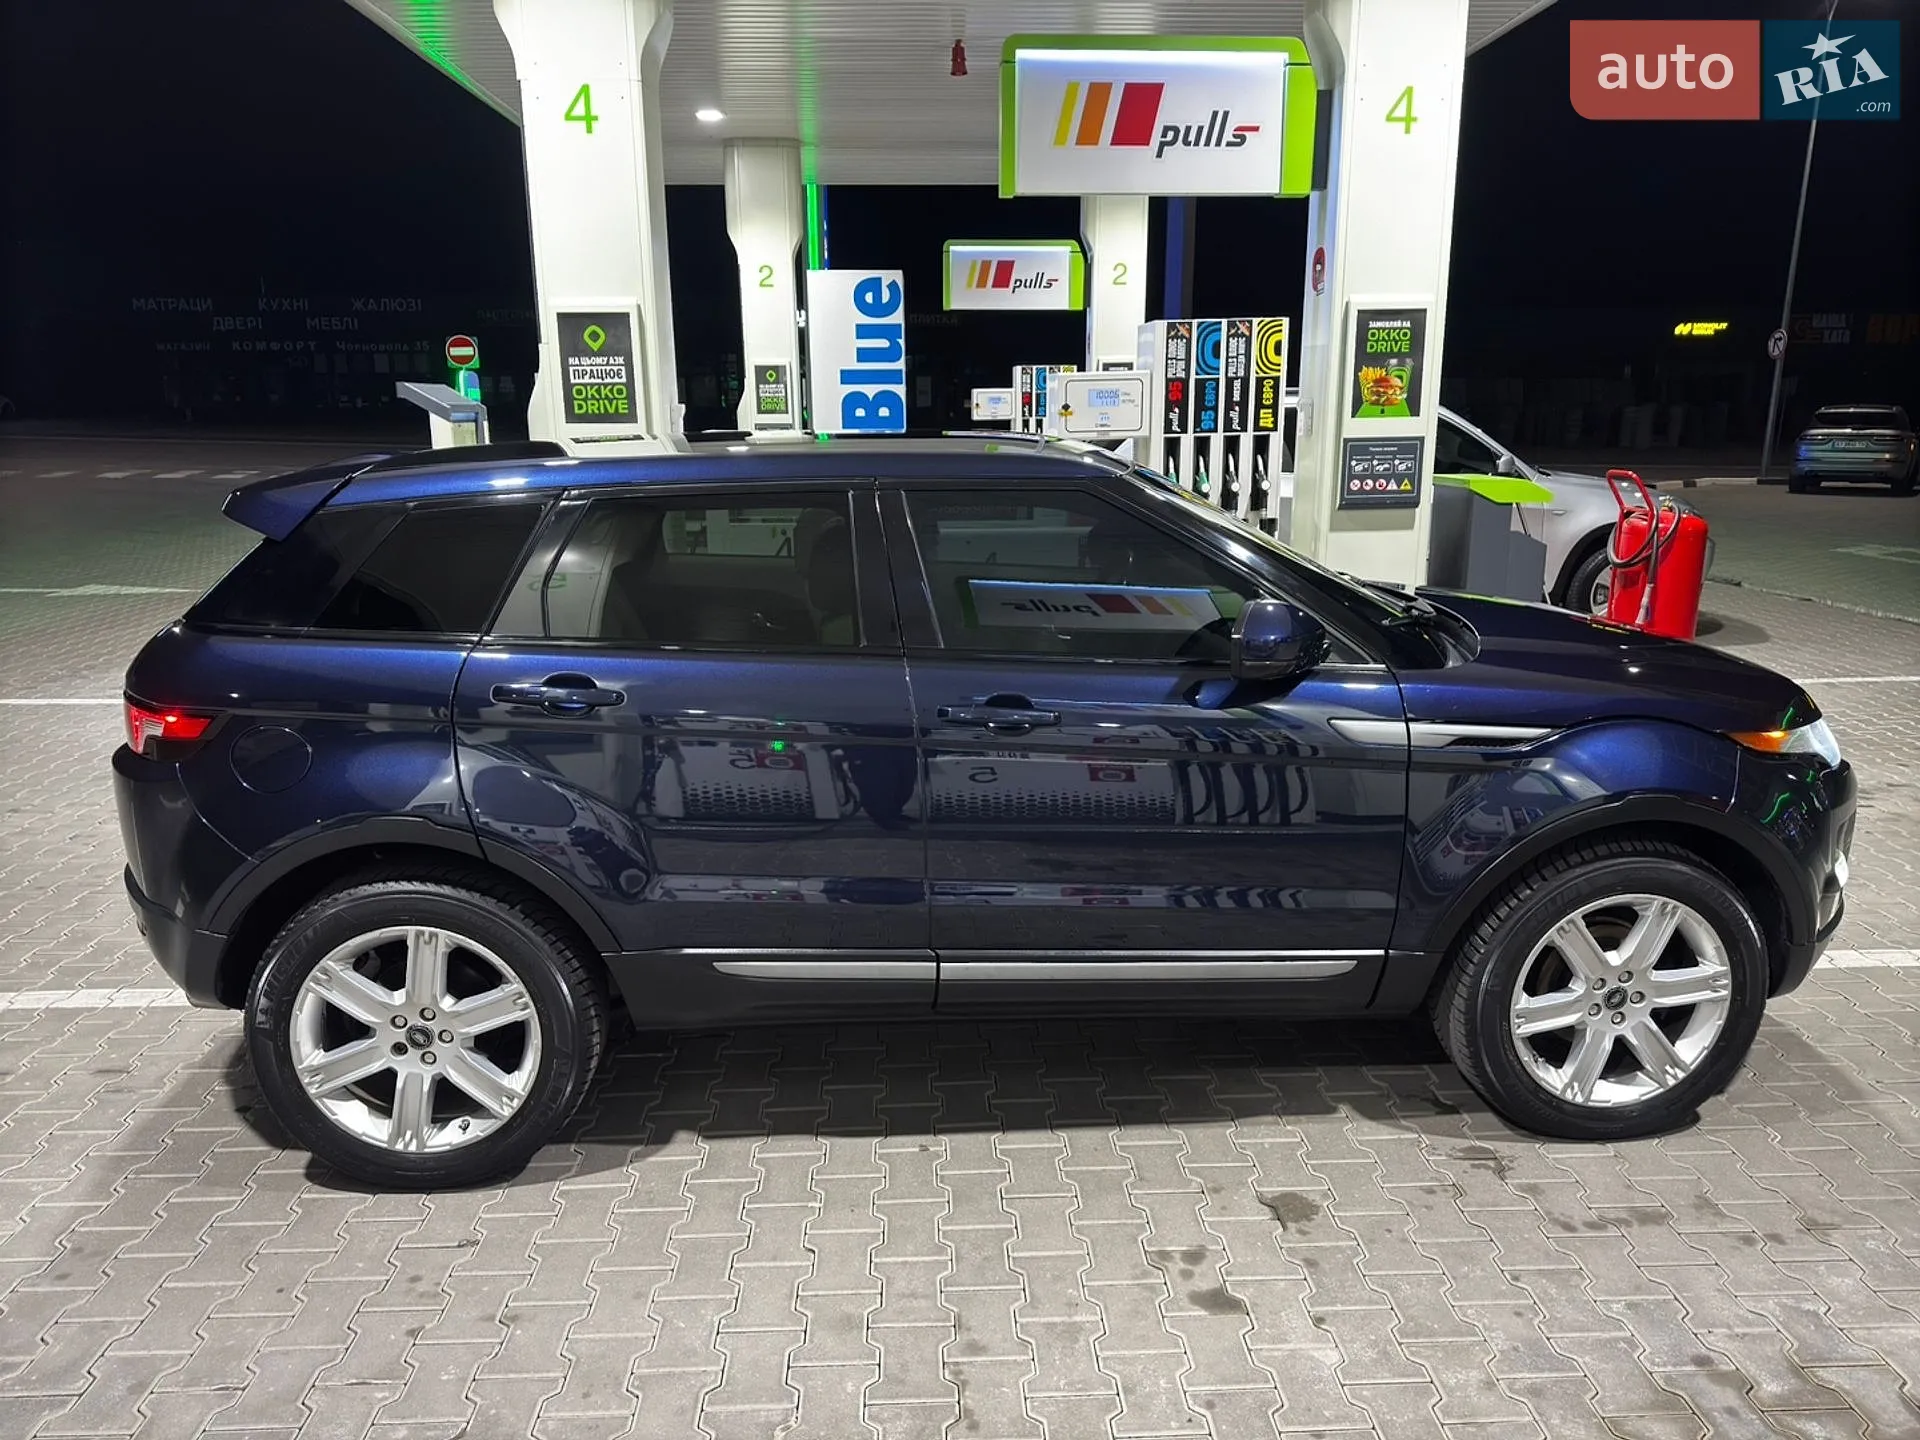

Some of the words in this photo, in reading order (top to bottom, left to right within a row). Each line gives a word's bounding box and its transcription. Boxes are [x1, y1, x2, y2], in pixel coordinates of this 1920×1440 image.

[564, 83, 598, 134] 4
[1385, 86, 1418, 134] 4
[1155, 110, 1260, 158] pulls
[758, 264, 774, 287] 2
[1012, 272, 1059, 294] pulls
[1112, 263, 1128, 286] 2
[1367, 329, 1411, 341] OKKO
[839, 276, 906, 430] Blue
[1366, 341, 1410, 353] DRIVE
[568, 356, 579, 365] НА
[580, 356, 608, 365] ЦЬОМУ
[608, 356, 625, 365] АЗК
[572, 368, 624, 381] ПРАЦЮЄ
[572, 385, 627, 399] OKKO
[1262, 379, 1274, 405] ЄВРО
[573, 400, 629, 414] DRIVE
[1201, 410, 1216, 430] 95
[1259, 408, 1274, 428] ДП
